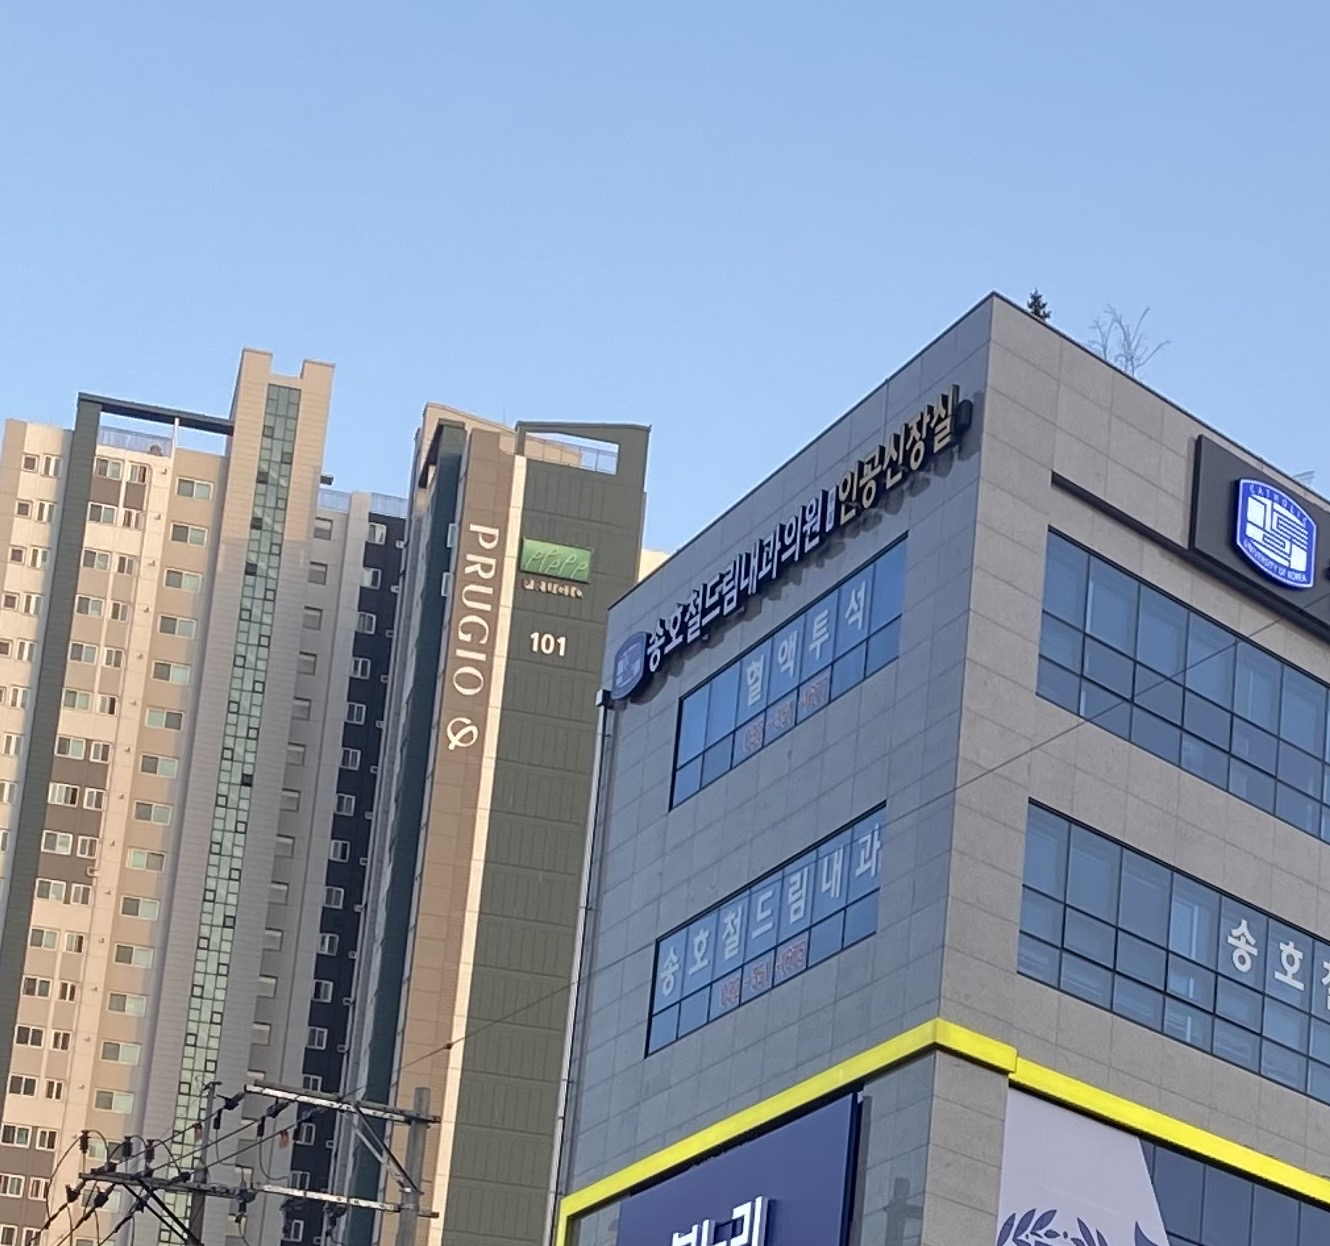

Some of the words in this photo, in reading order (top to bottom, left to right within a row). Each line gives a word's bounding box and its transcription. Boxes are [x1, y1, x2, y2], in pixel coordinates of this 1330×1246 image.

[451, 523, 500, 696] PRUGIO
[530, 631, 567, 657] 101
[646, 491, 823, 673] 송호철드림내과의원
[746, 580, 867, 708] 혈액투석
[660, 822, 882, 996] 송호철드림내과
